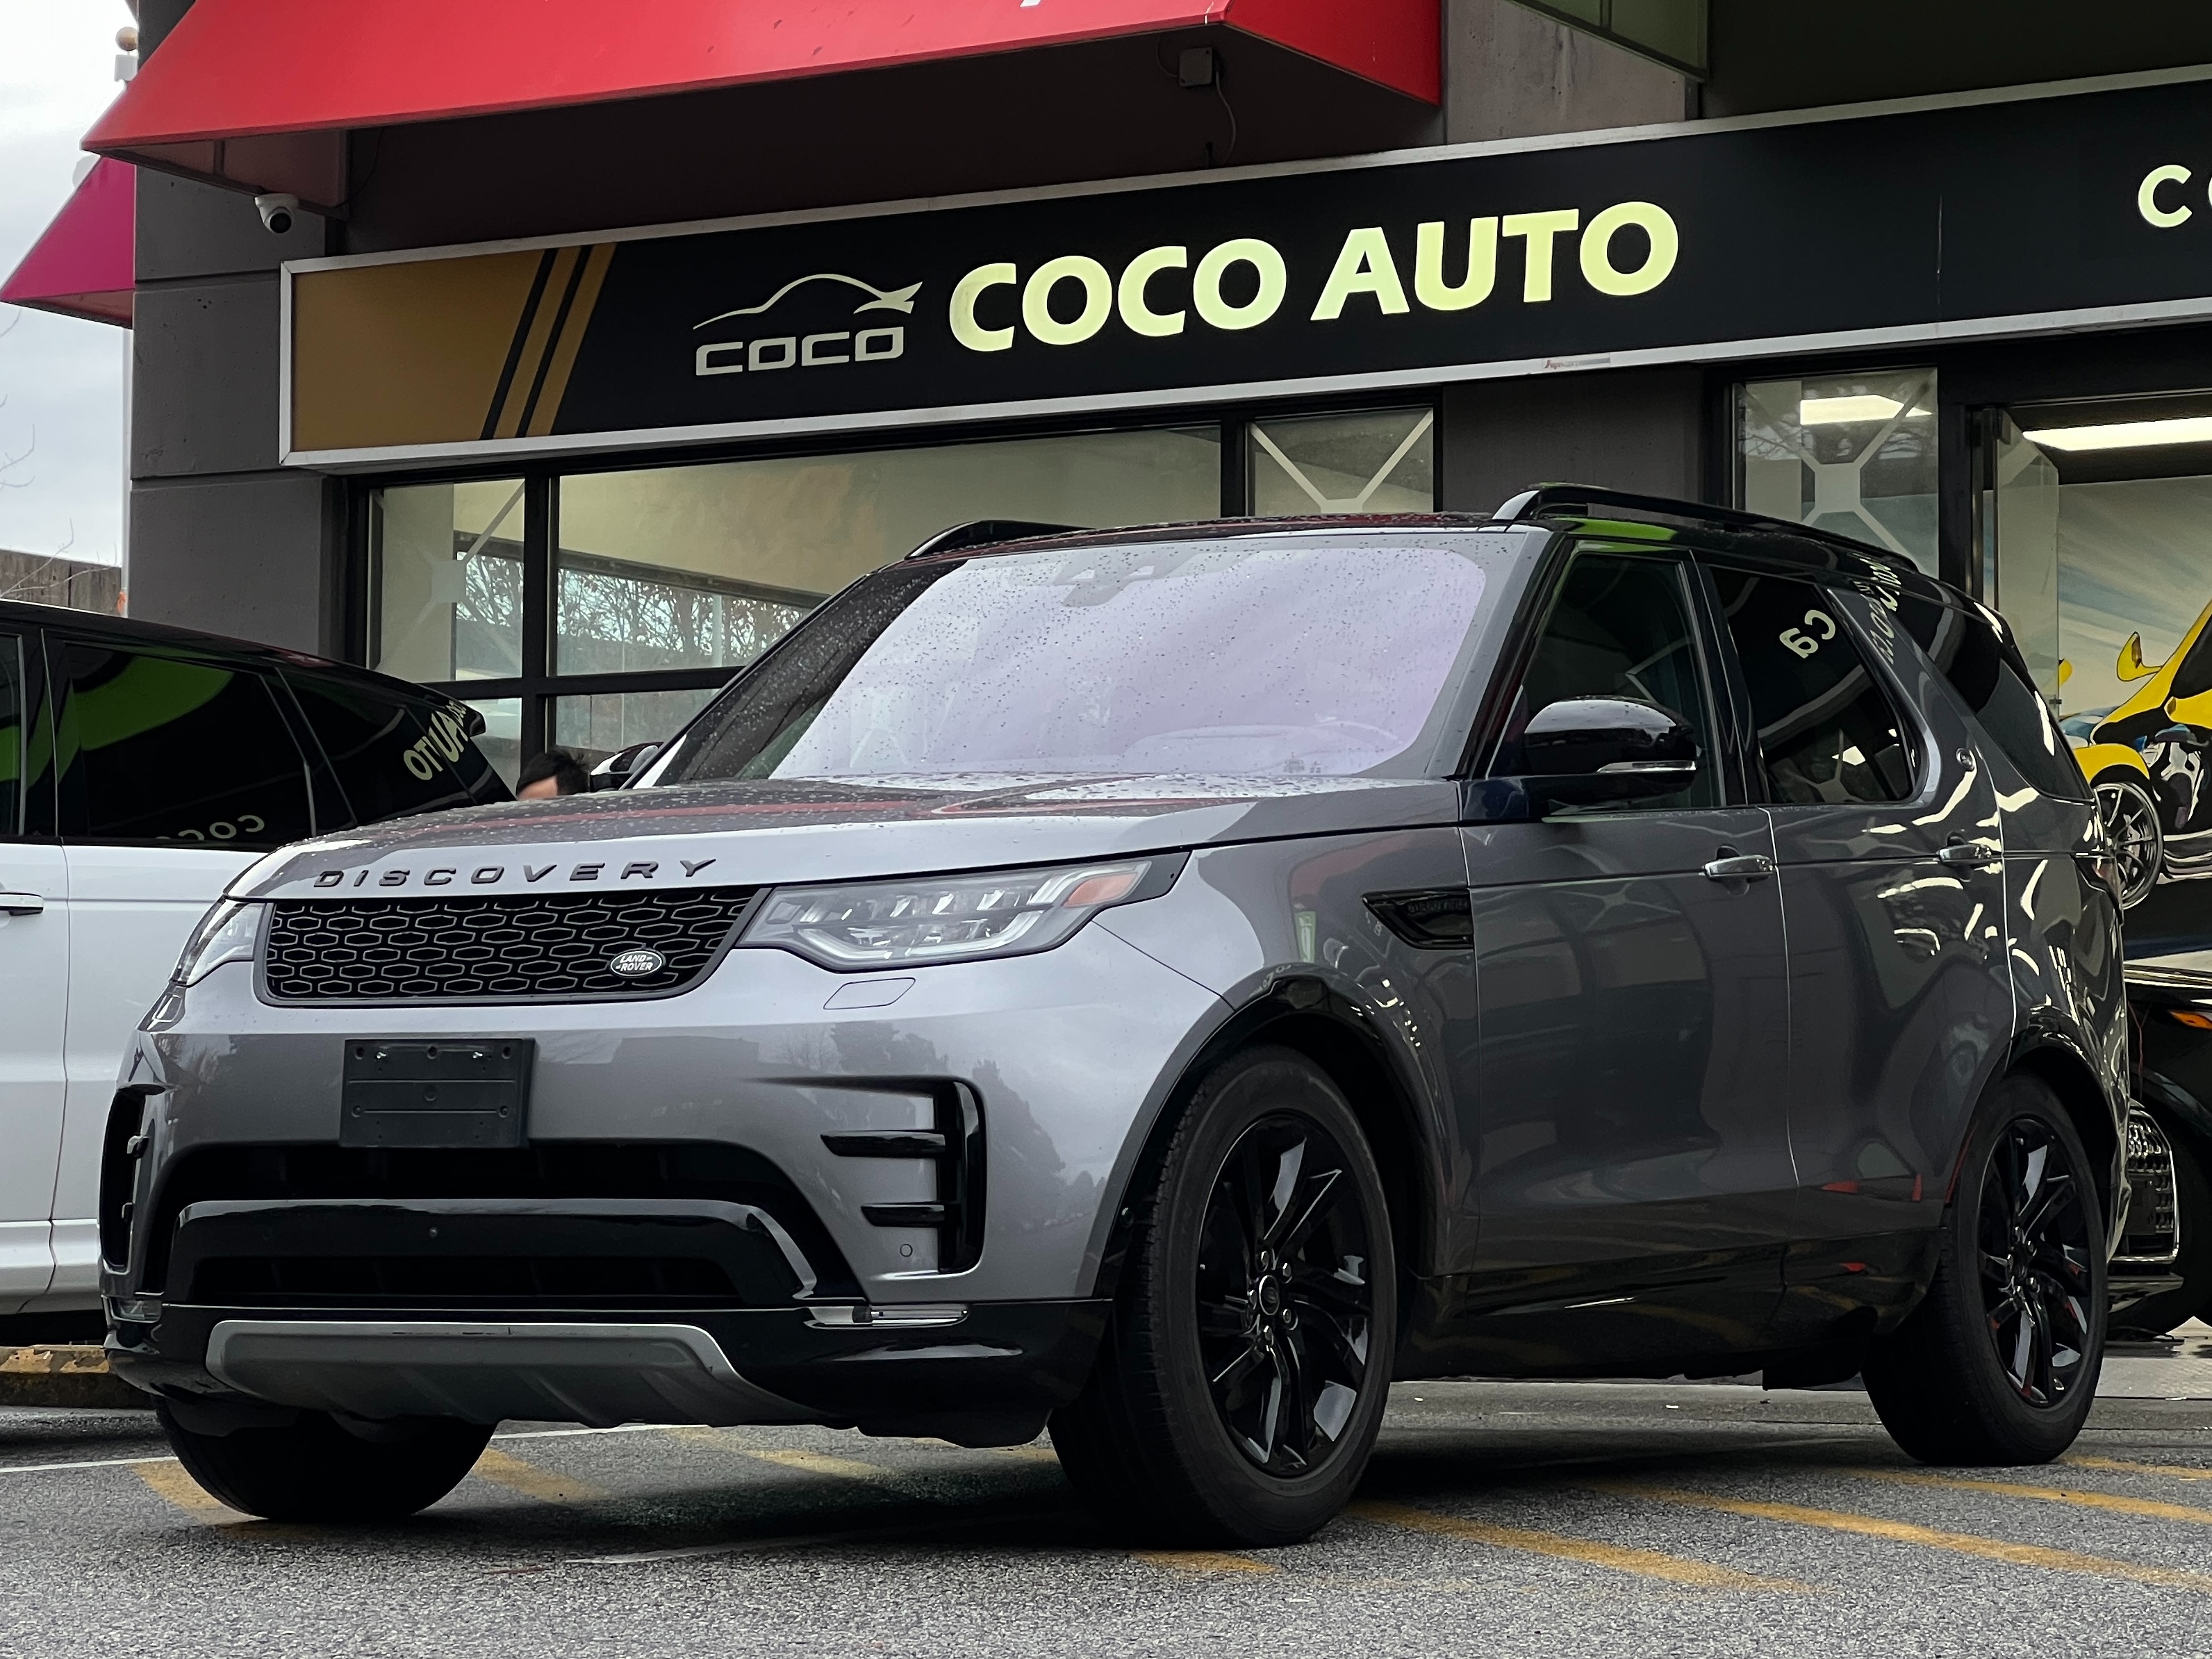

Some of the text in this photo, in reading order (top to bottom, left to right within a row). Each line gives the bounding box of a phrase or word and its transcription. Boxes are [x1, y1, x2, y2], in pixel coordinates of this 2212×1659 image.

[2138, 164, 2212, 228] C
[950, 201, 1678, 352] COCO AUTO
[695, 326, 904, 377] COCO
[313, 859, 716, 888] DISCOVERY
